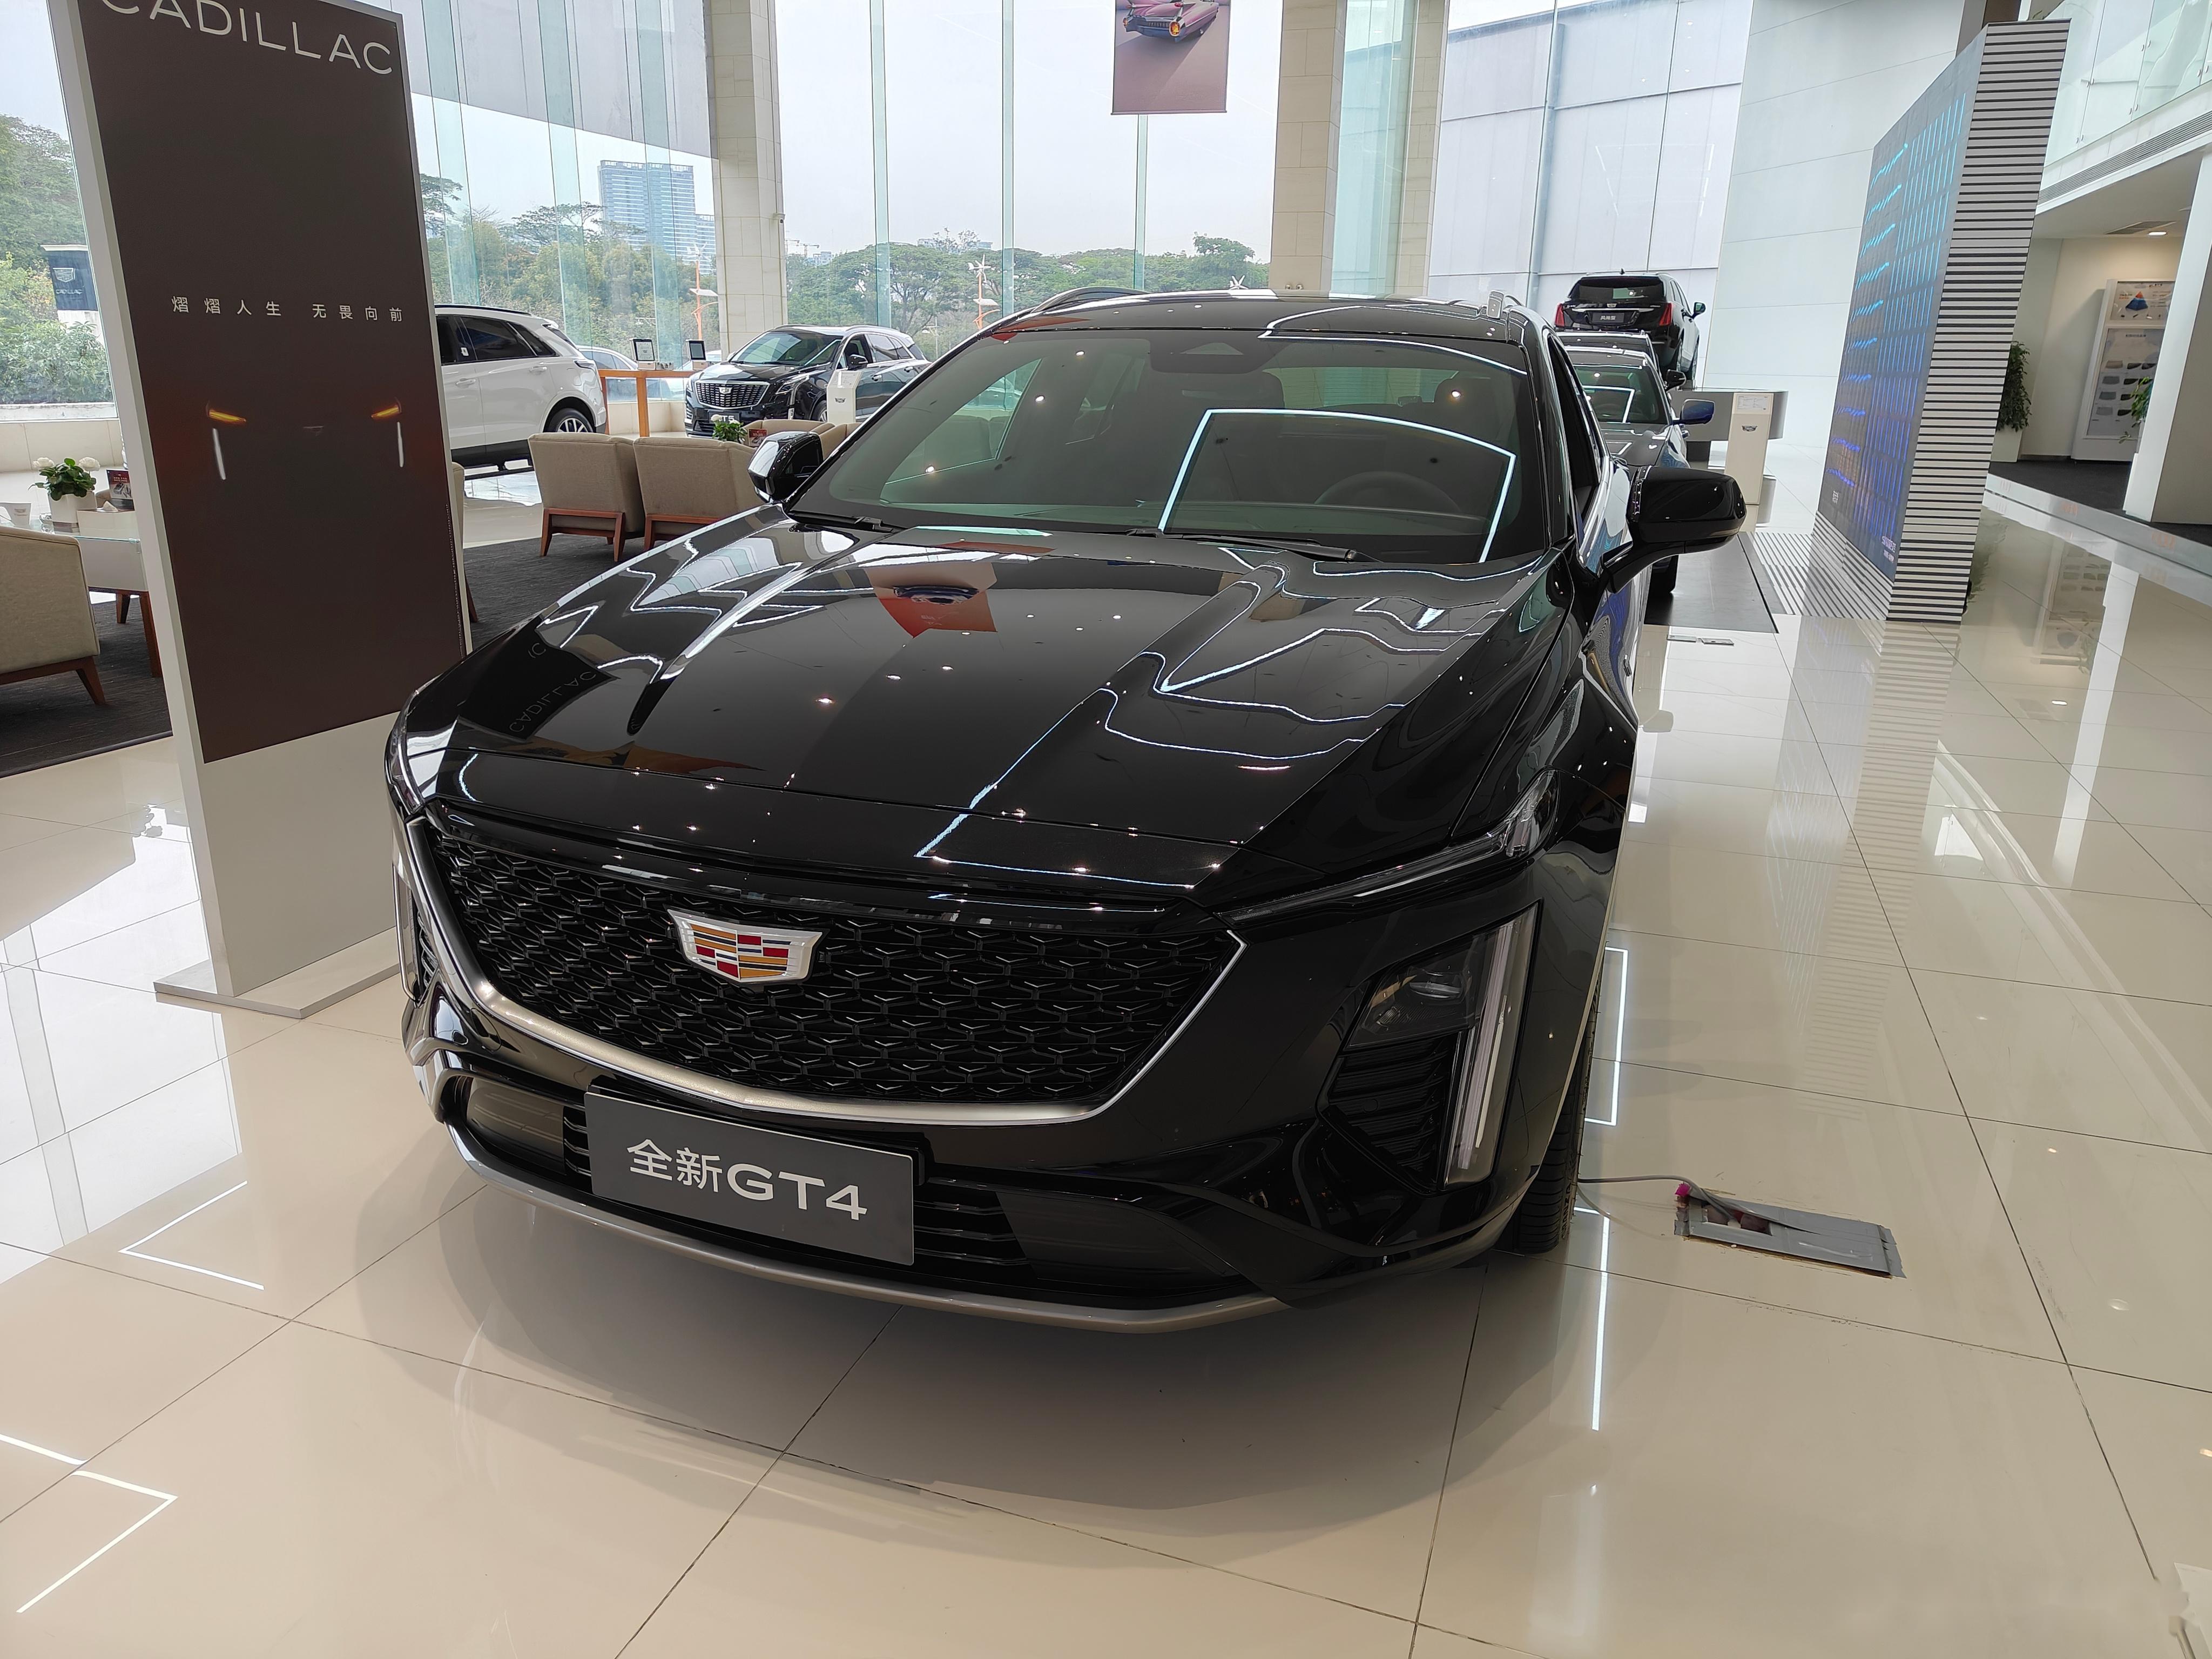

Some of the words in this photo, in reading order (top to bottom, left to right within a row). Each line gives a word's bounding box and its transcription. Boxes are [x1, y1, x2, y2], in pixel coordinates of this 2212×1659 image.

[171, 295, 282, 316] 熠熠人生
[312, 303, 402, 322] 无畏向前
[627, 1139, 867, 1220] 全新GT4
